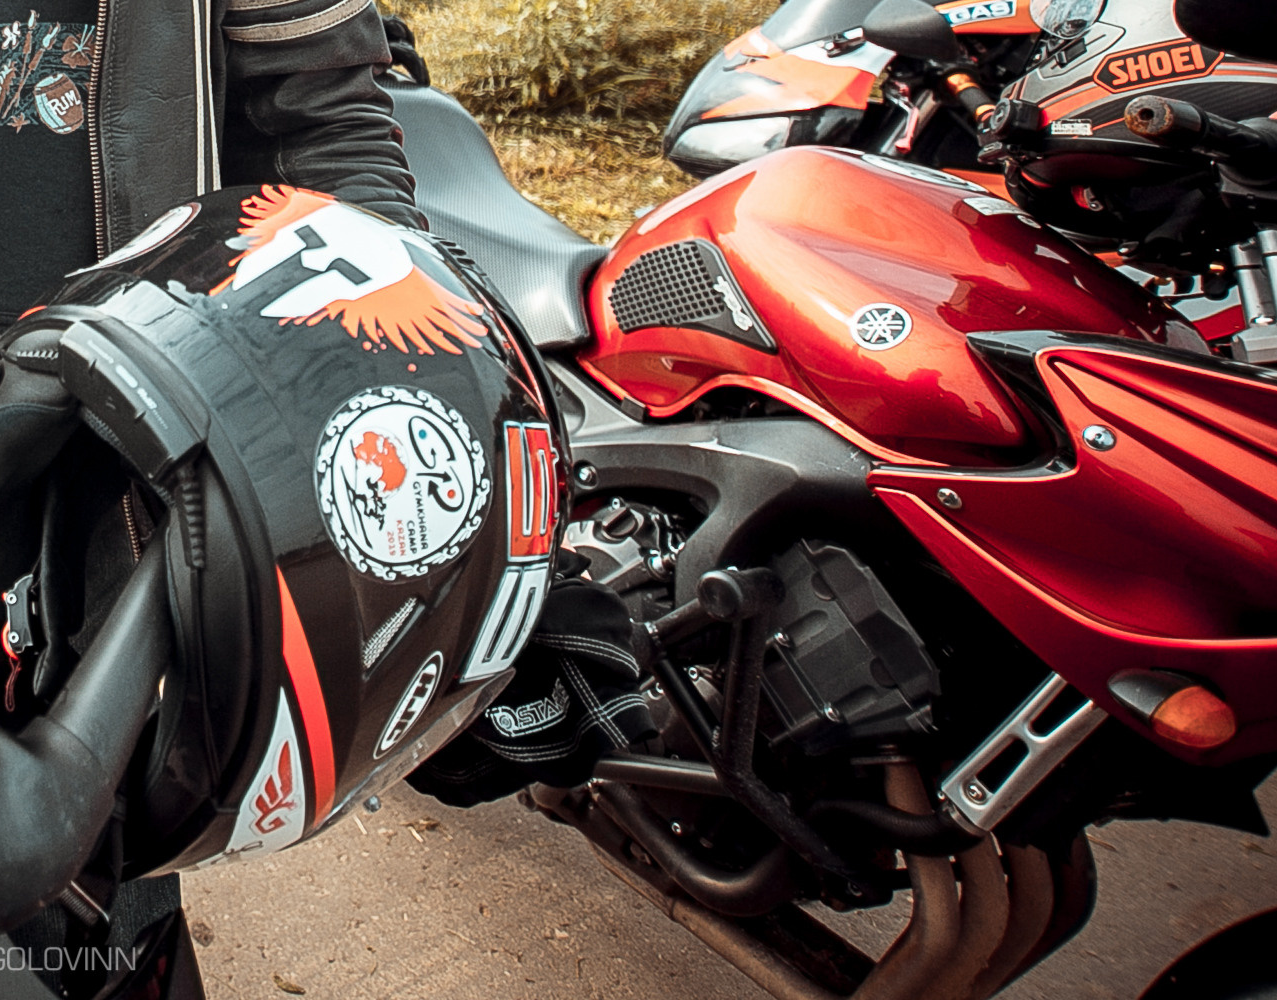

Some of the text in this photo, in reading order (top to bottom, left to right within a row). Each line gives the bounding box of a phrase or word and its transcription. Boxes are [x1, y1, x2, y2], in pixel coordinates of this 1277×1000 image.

[1108, 44, 1205, 86] SHOEI
[45, 89, 81, 116] RUM
[412, 481, 428, 550] GYMKHANA
[396, 520, 407, 556] KAZAN
[407, 520, 418, 555] CAMP
[386, 672, 436, 743] HJC
